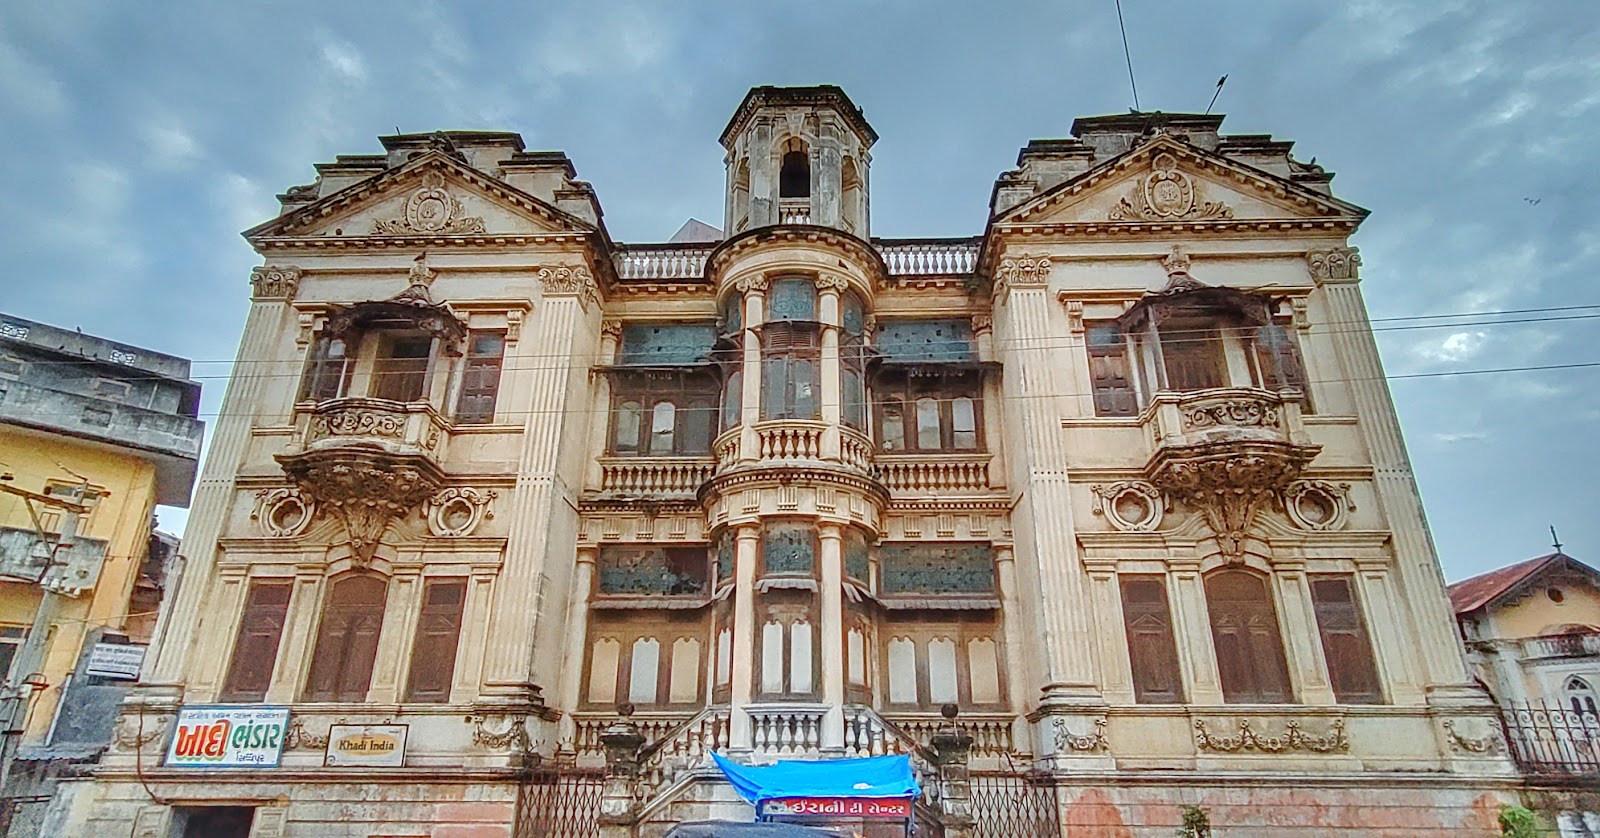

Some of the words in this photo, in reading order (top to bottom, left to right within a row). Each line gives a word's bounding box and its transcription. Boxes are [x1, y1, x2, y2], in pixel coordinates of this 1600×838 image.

[175, 719, 231, 757] ખાદી
[232, 719, 280, 749] ભંડાર
[338, 740, 367, 751] Khadi
[369, 740, 395, 751] India
[793, 799, 845, 813] ઈરાની
[849, 801, 862, 814] ટી
[868, 802, 905, 814] સેન્ટર
